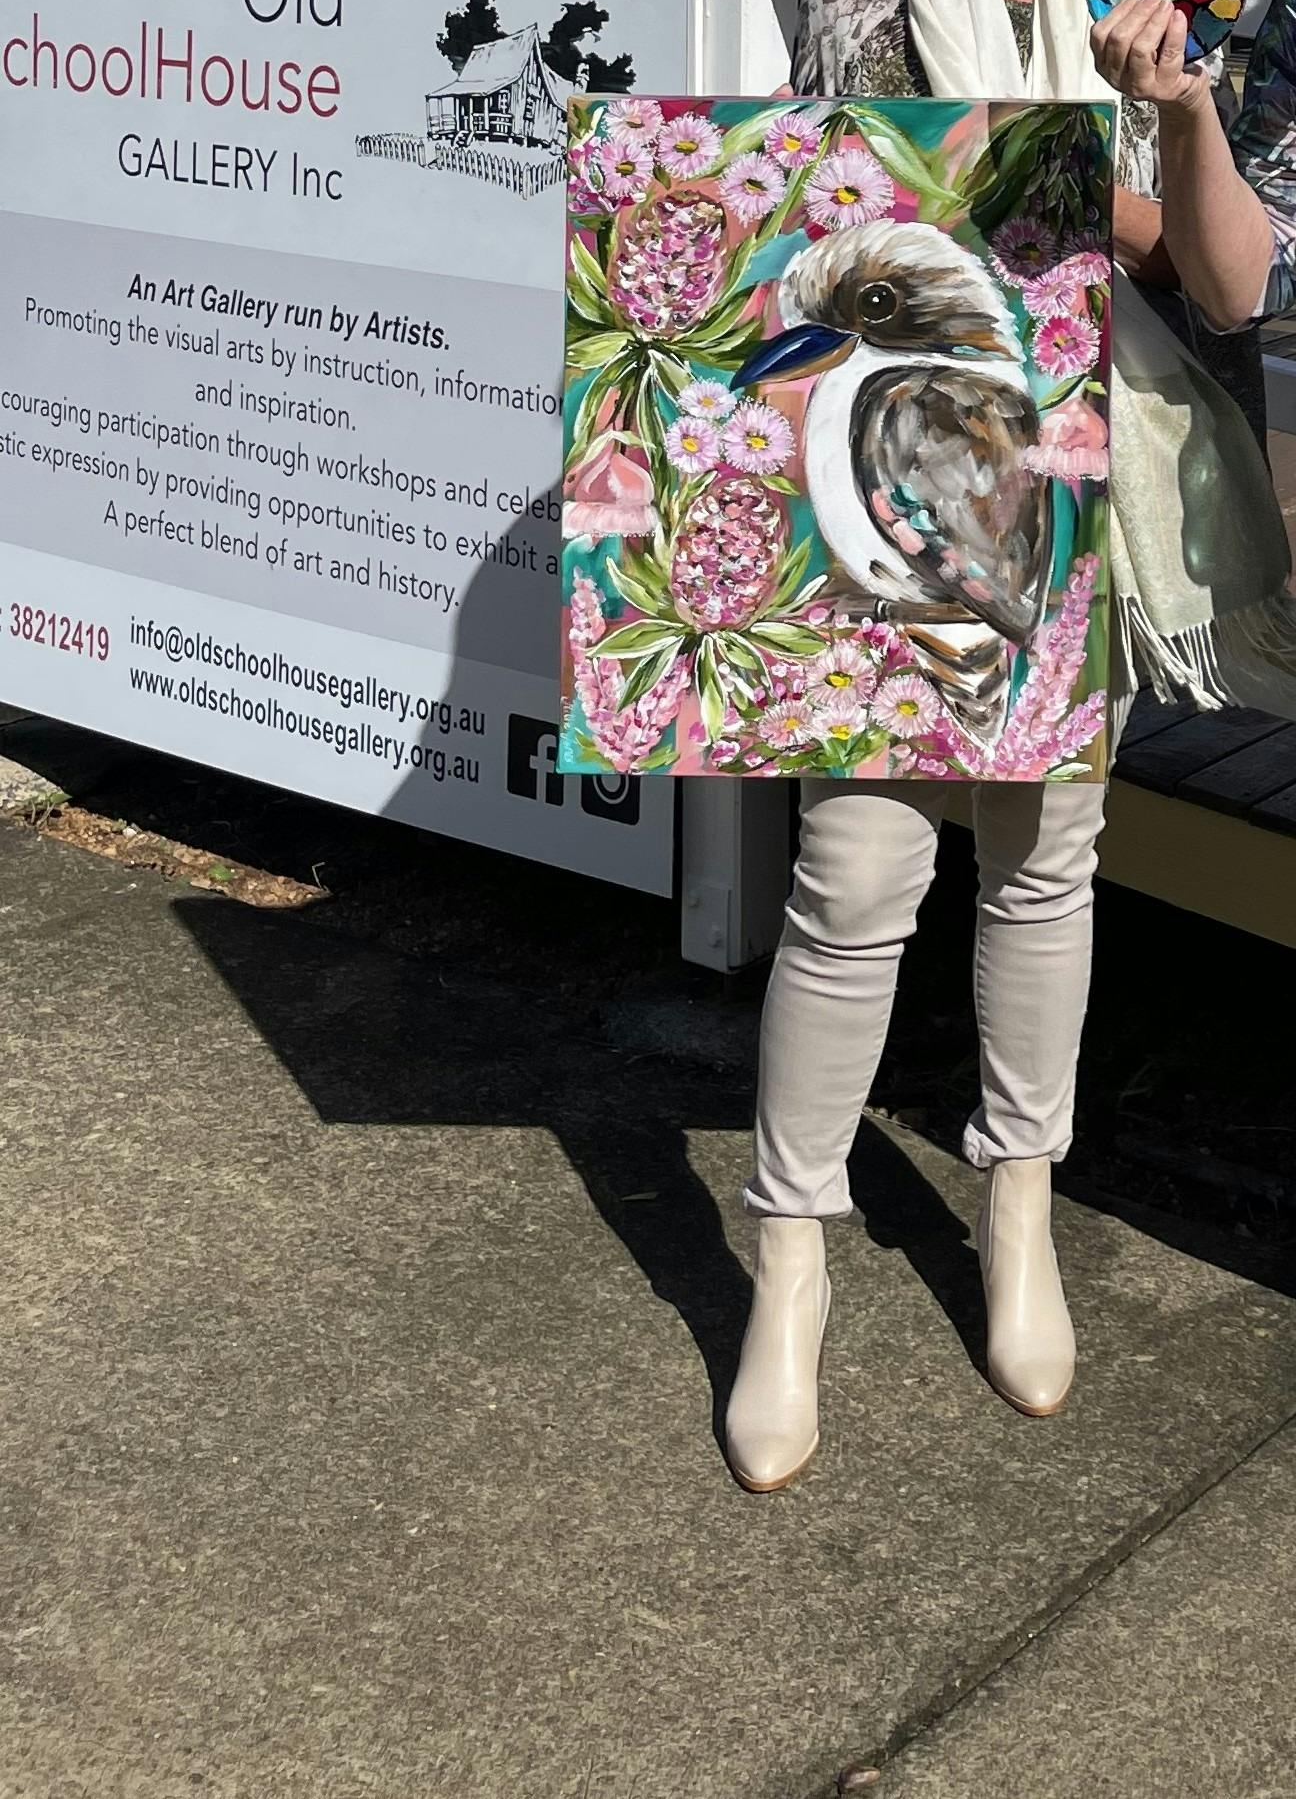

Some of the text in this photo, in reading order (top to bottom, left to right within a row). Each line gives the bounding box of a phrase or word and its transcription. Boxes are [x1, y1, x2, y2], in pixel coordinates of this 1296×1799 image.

[4, 13, 340, 117] choolHouse
[119, 134, 342, 200] GALLERY Inc
[26, 297, 120, 345] Promoting
[128, 315, 158, 345] the
[166, 324, 219, 356] visual
[227, 340, 263, 363] arts
[272, 338, 296, 377] by
[304, 346, 425, 397] instruction,
[127, 274, 449, 350] An Art Gallery run by Artists.
[196, 380, 356, 432] and inspiration.
[32, 444, 129, 481] expression
[137, 457, 159, 495] by
[166, 474, 260, 519] providing
[269, 497, 415, 544] opportunities
[423, 525, 446, 551] to
[455, 530, 538, 572] exhibit
[98, 412, 219, 453] participation
[227, 430, 308, 477] through
[317, 454, 436, 502] workshops
[445, 478, 487, 508] and
[104, 500, 460, 610] A perfect blend of art and history.
[10, 603, 109, 660] 38212419
[131, 616, 485, 735] info@oldschoolhousegallery.org.au
[130, 668, 479, 783] www.oldschoolhousegallery.org.au
